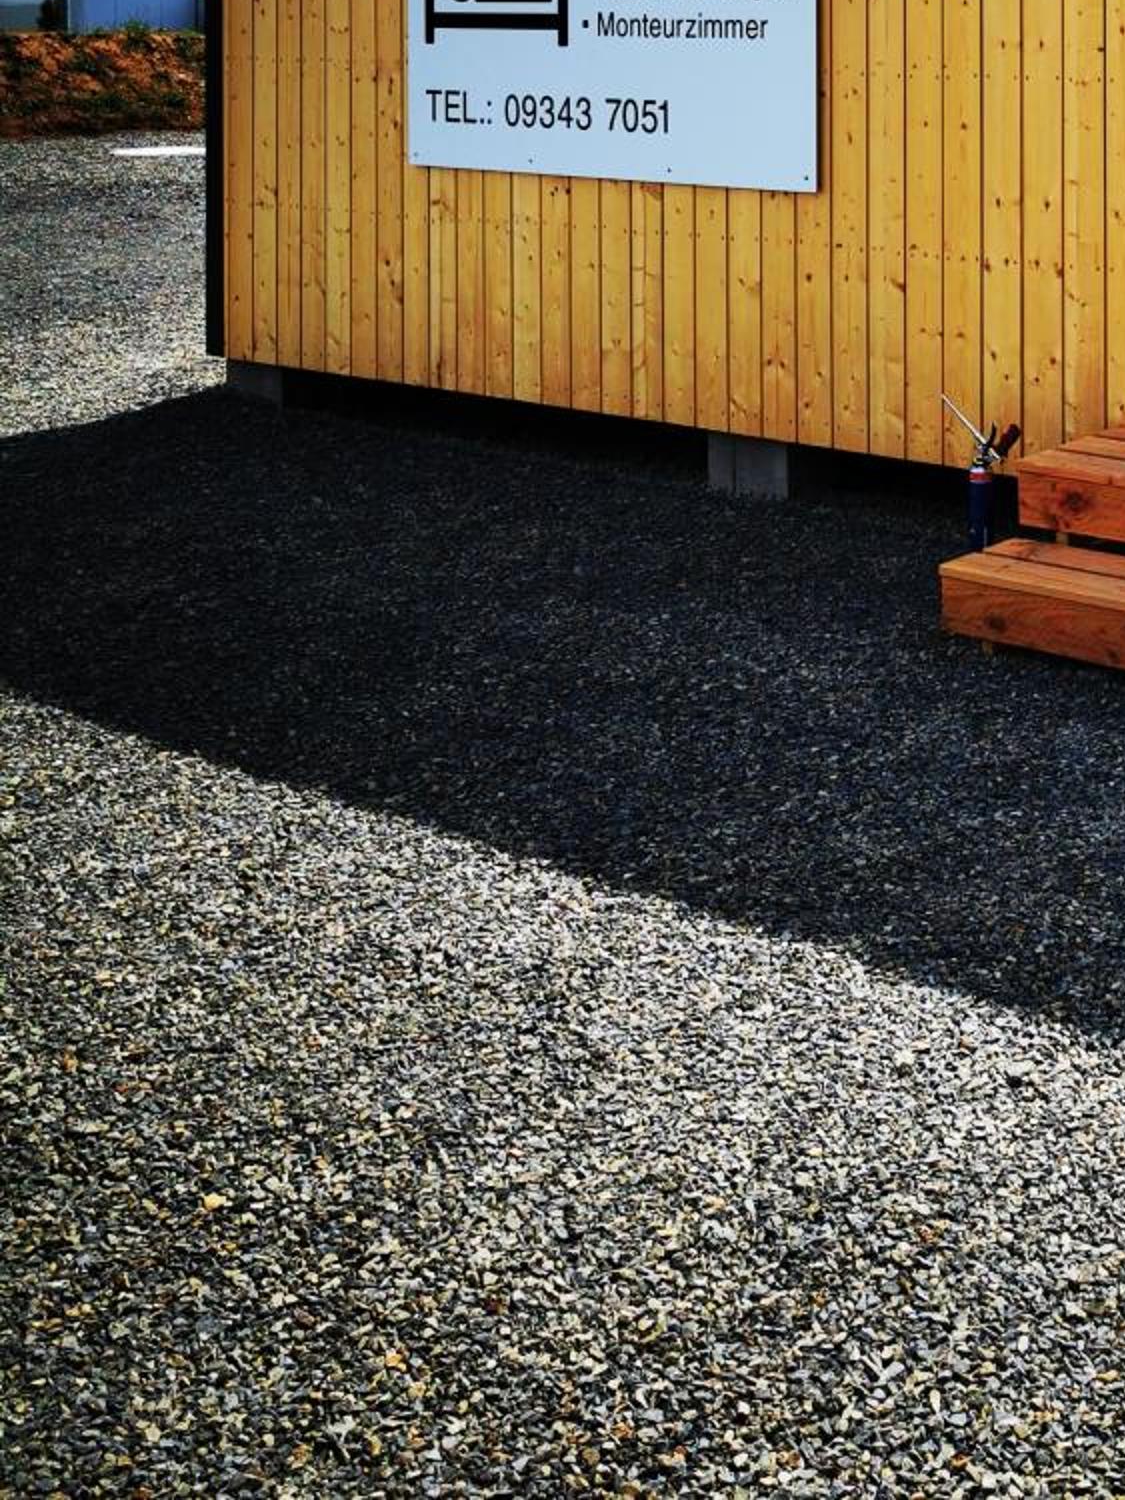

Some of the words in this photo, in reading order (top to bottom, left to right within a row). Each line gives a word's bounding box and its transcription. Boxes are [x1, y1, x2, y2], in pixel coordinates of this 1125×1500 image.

[597, 12, 768, 40] Monteurzimmer
[425, 89, 492, 125] TEL.:
[504, 94, 593, 131] 09343
[605, 99, 671, 134] 7051
